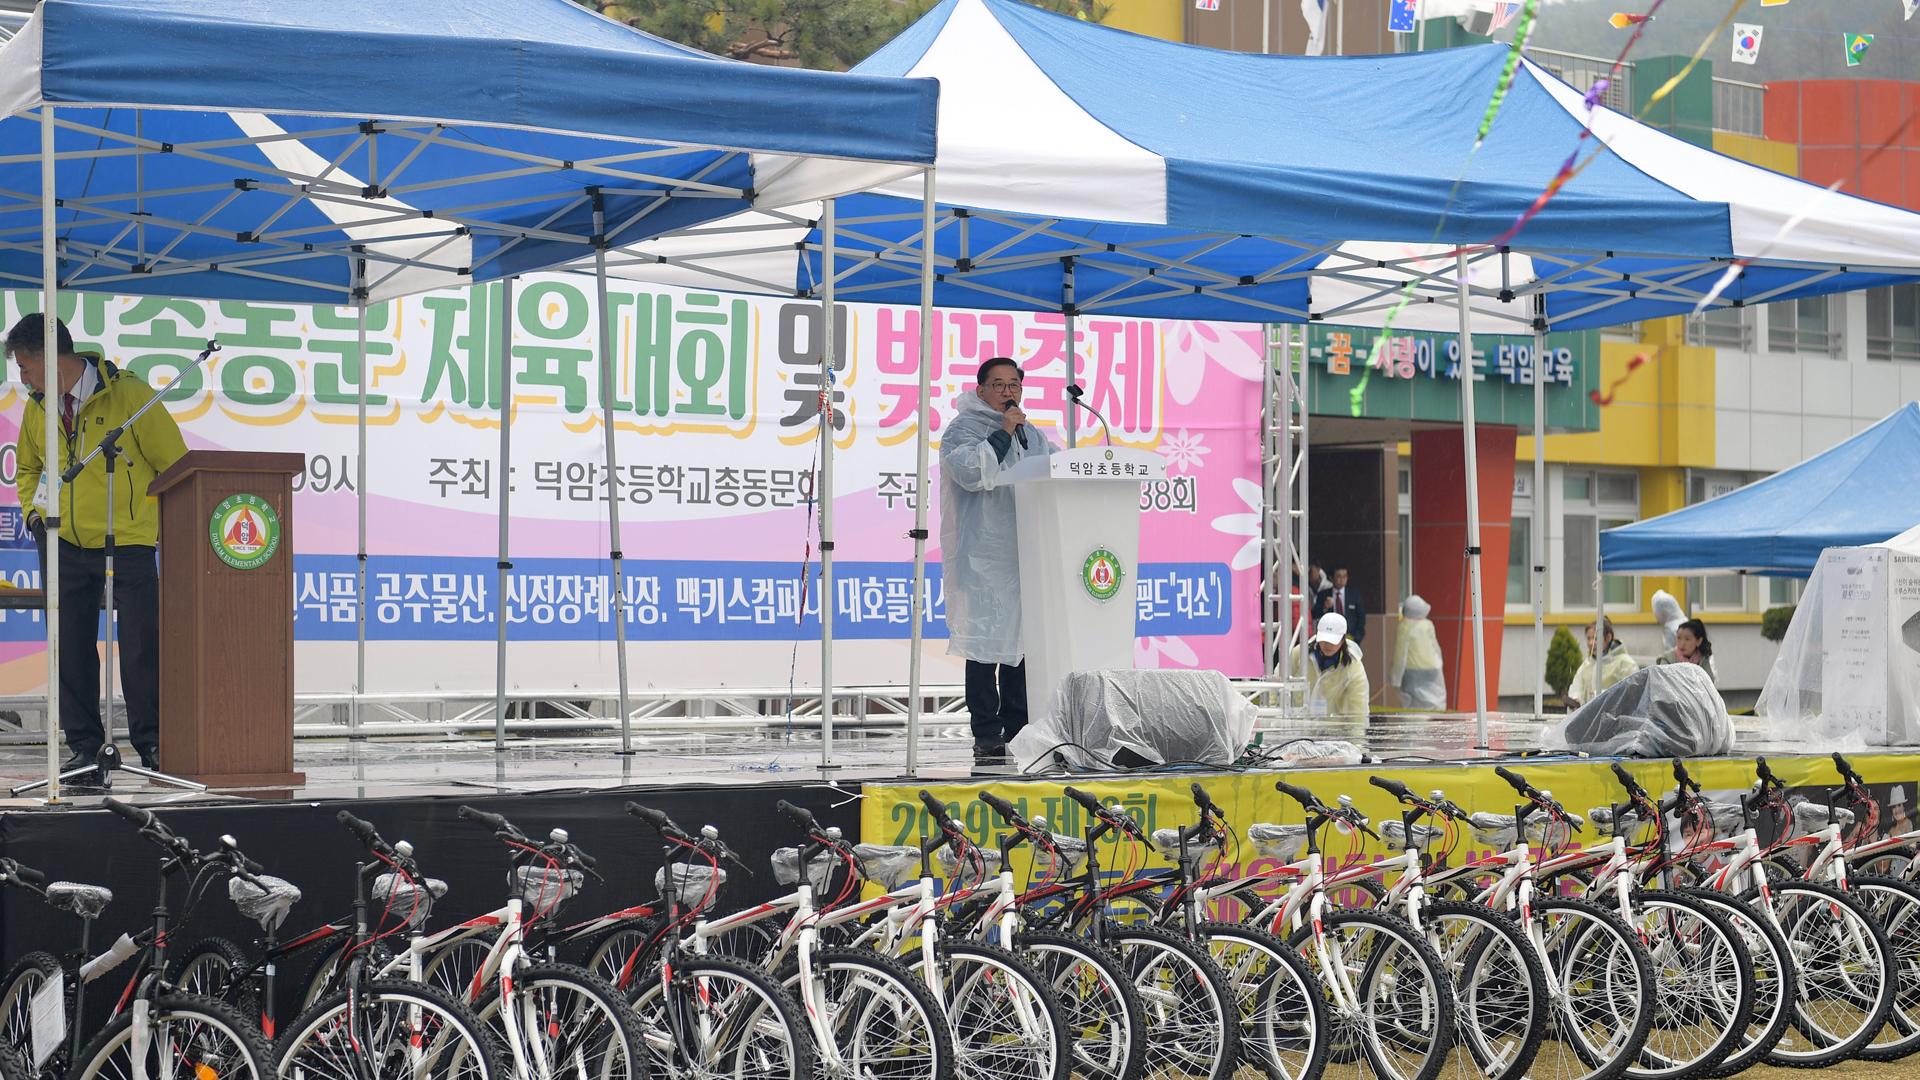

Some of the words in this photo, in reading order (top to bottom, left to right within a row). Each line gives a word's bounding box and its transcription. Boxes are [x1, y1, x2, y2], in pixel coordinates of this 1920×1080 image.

[421, 279, 748, 420] 체육대회
[778, 303, 848, 432] 및
[1493, 344, 1573, 386] 덕암교육
[429, 457, 490, 499] 주최
[535, 461, 823, 507] 덕암초등학교총동문회
[212, 532, 225, 557] DUKAM
[223, 554, 264, 567] ELEMENTARY
[263, 535, 278, 560] SCHOOL
[293, 572, 358, 622] 식품
[676, 577, 823, 624] 맥키스컴퍼니
